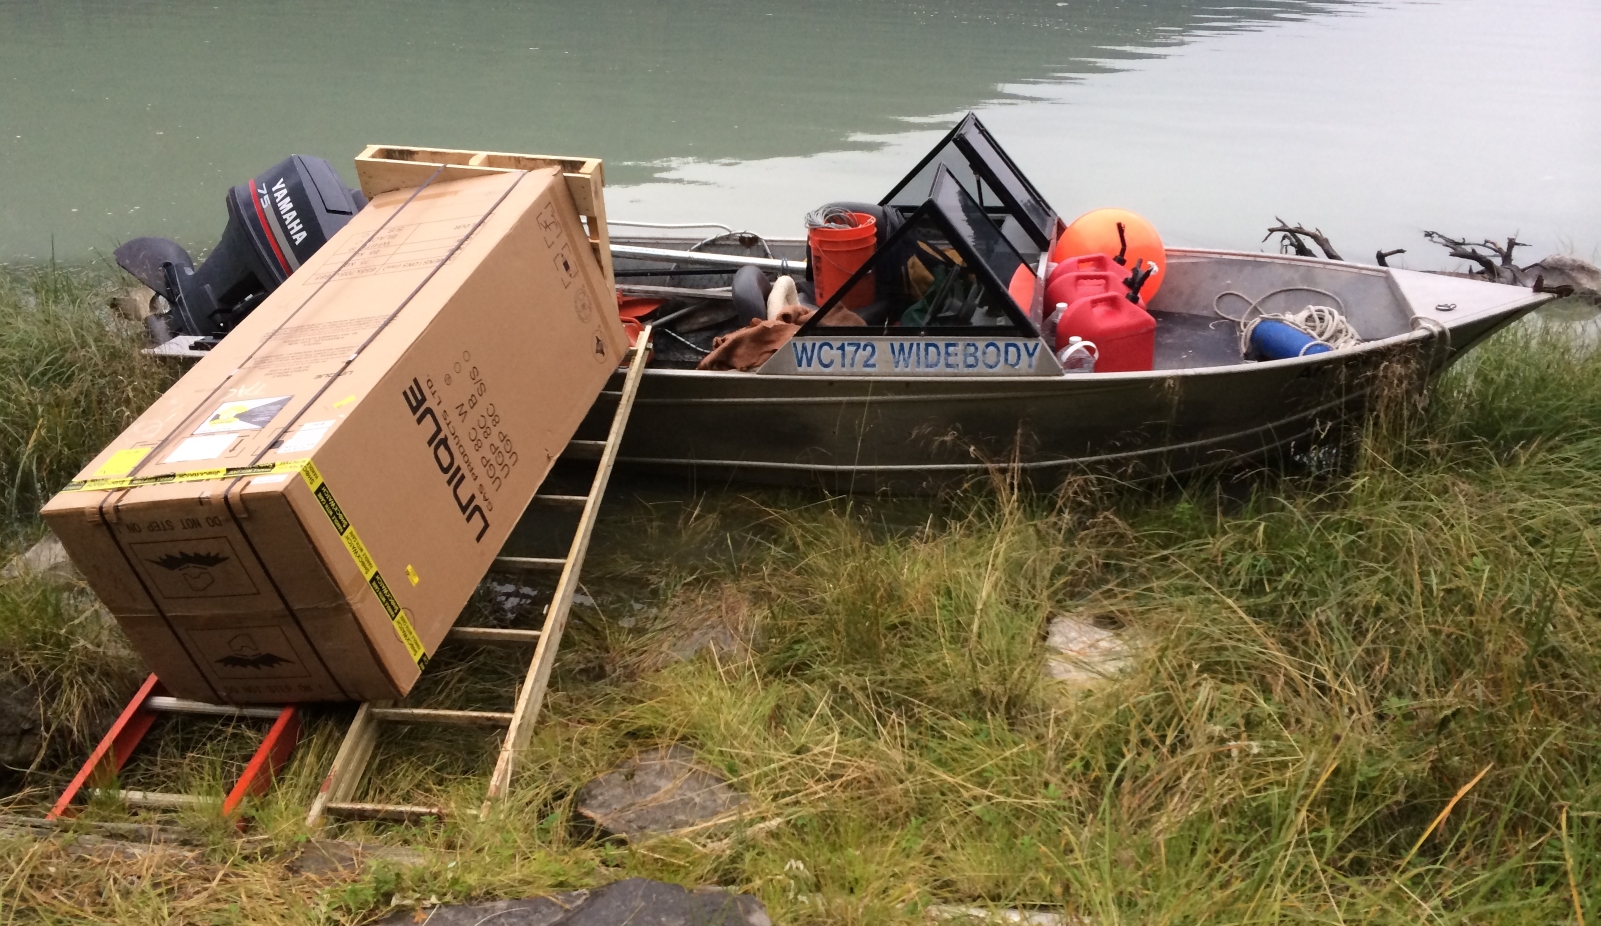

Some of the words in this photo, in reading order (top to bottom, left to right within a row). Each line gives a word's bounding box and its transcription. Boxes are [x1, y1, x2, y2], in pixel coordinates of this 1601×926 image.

[257, 183, 270, 209] 75
[272, 177, 308, 246] YAMAHA
[792, 342, 877, 369] WC172
[890, 342, 1040, 370] WIDEBODY
[469, 365, 487, 397] S/S
[455, 402, 468, 424] W
[467, 393, 479, 410] B
[441, 409, 478, 482] PRODUCTS
[497, 430, 519, 467] UGP
[402, 376, 490, 544] UNIQUE
[490, 442, 510, 480] UGP
[480, 455, 502, 492] UGP
[318, 493, 326, 505] CARE
[321, 486, 348, 528] SHOCKWATCH
[325, 504, 333, 516] WITH
[478, 483, 493, 512] GAS
[126, 522, 142, 534] ON
[147, 519, 174, 533] STEP
[181, 517, 202, 530] NOT
[206, 515, 223, 528] DO
[331, 515, 343, 532] HANDLE
[349, 531, 357, 543] CARE
[344, 535, 369, 575] SHOCKWATCH
[362, 552, 373, 570] HANDLE
